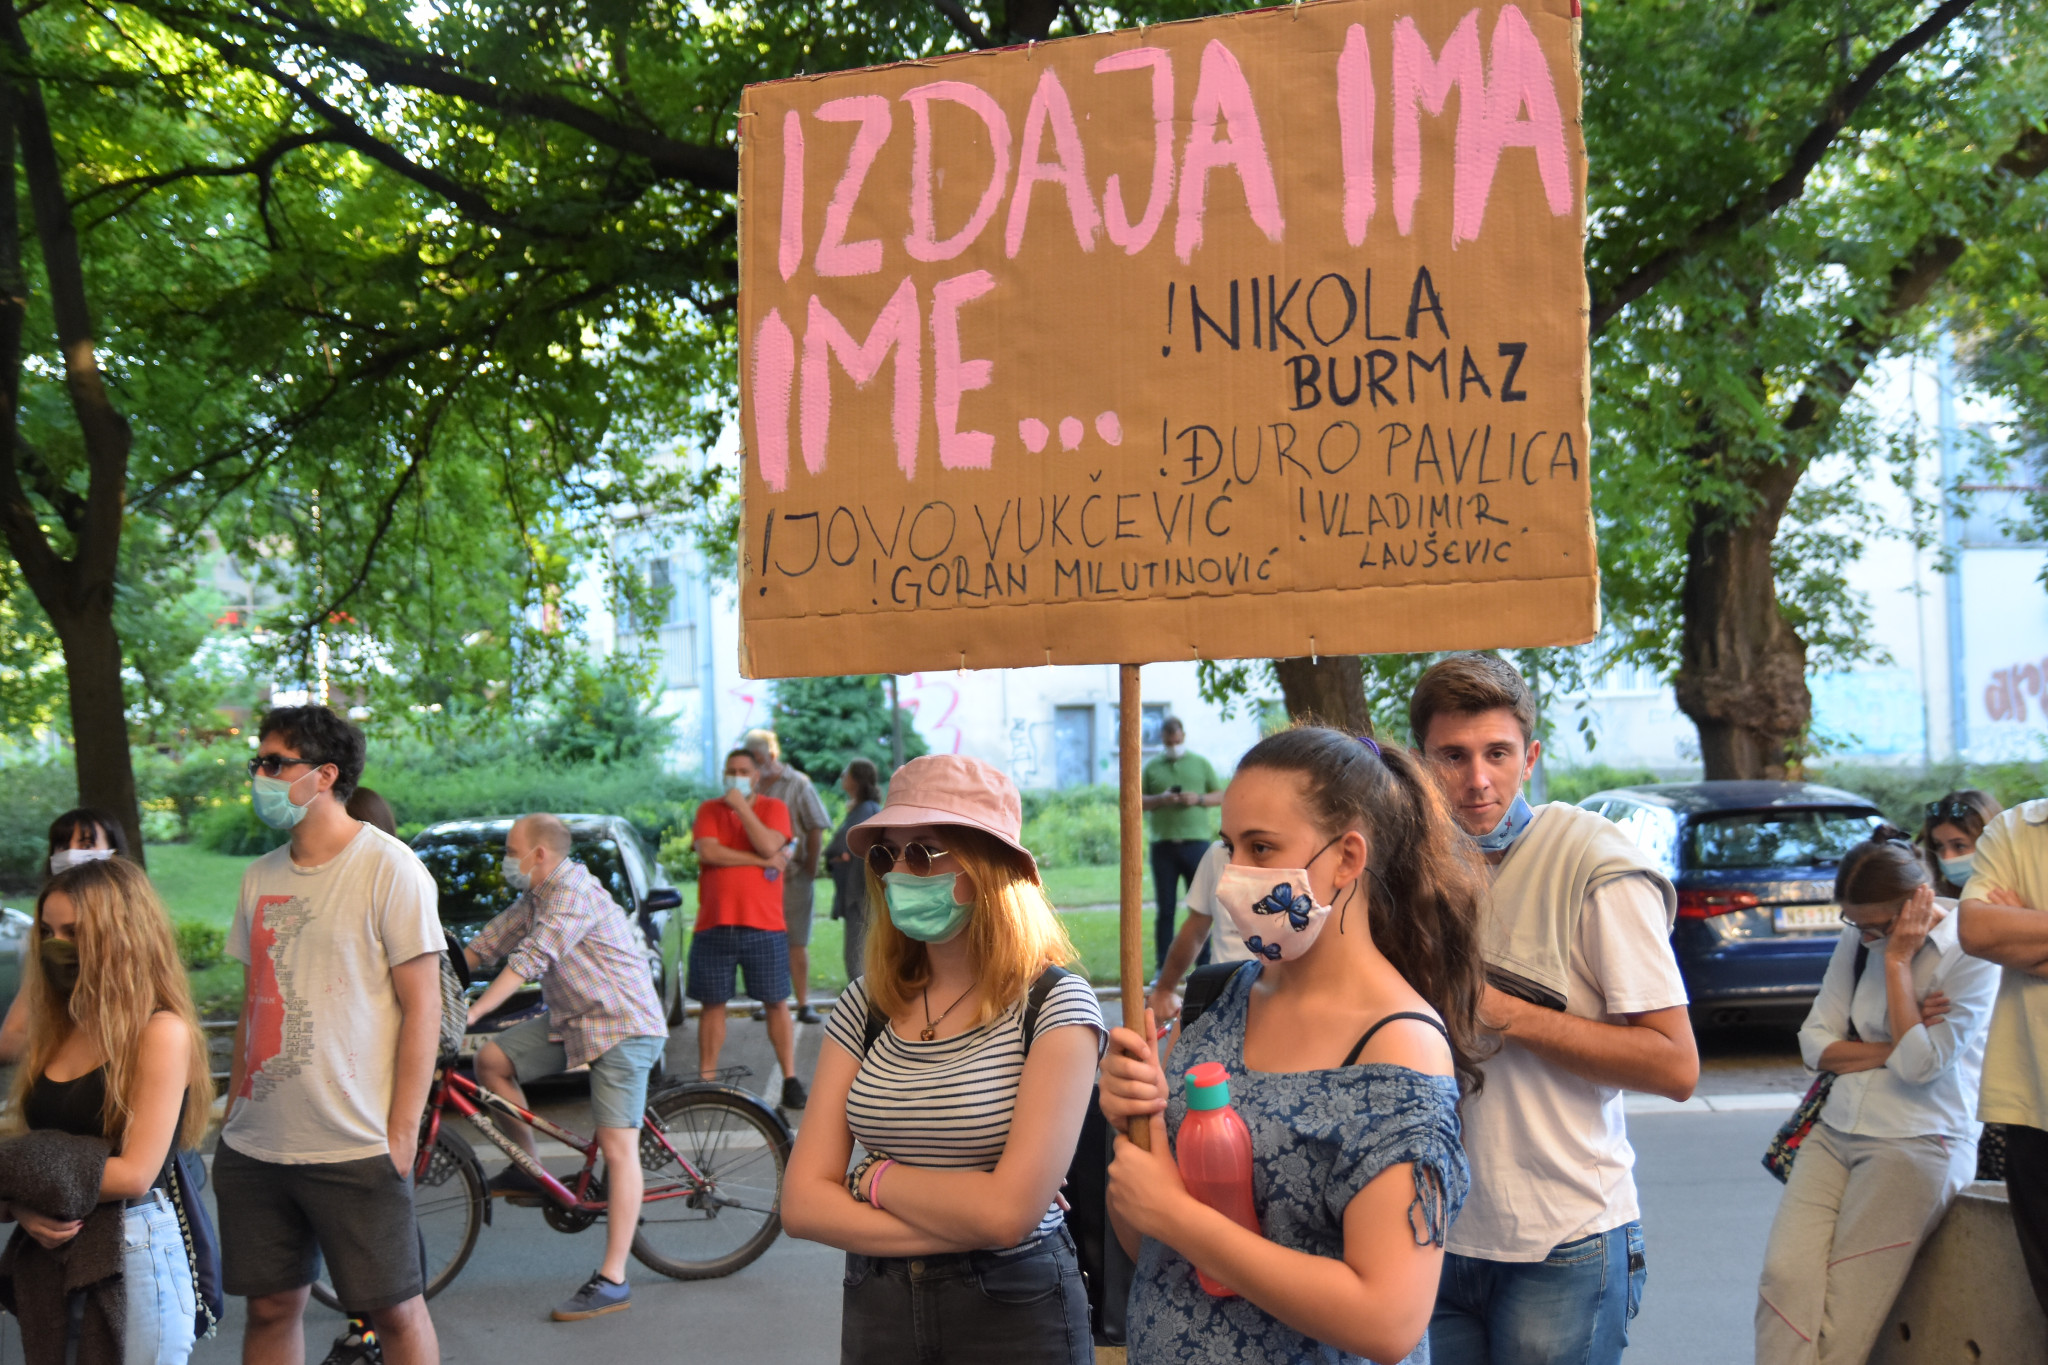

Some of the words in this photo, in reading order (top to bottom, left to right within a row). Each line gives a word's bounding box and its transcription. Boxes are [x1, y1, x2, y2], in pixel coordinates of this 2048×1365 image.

[779, 38, 1285, 282] IZDAJA
[1337, 3, 1572, 252] IMA
[752, 269, 1123, 493] IME...
[1283, 341, 1527, 412] BURMAZ
[1378, 421, 1579, 487] PAVLICA
[974, 468, 1233, 561] VUKČEVIĆ
[1054, 546, 1280, 598] MILUTINOVIĆ
